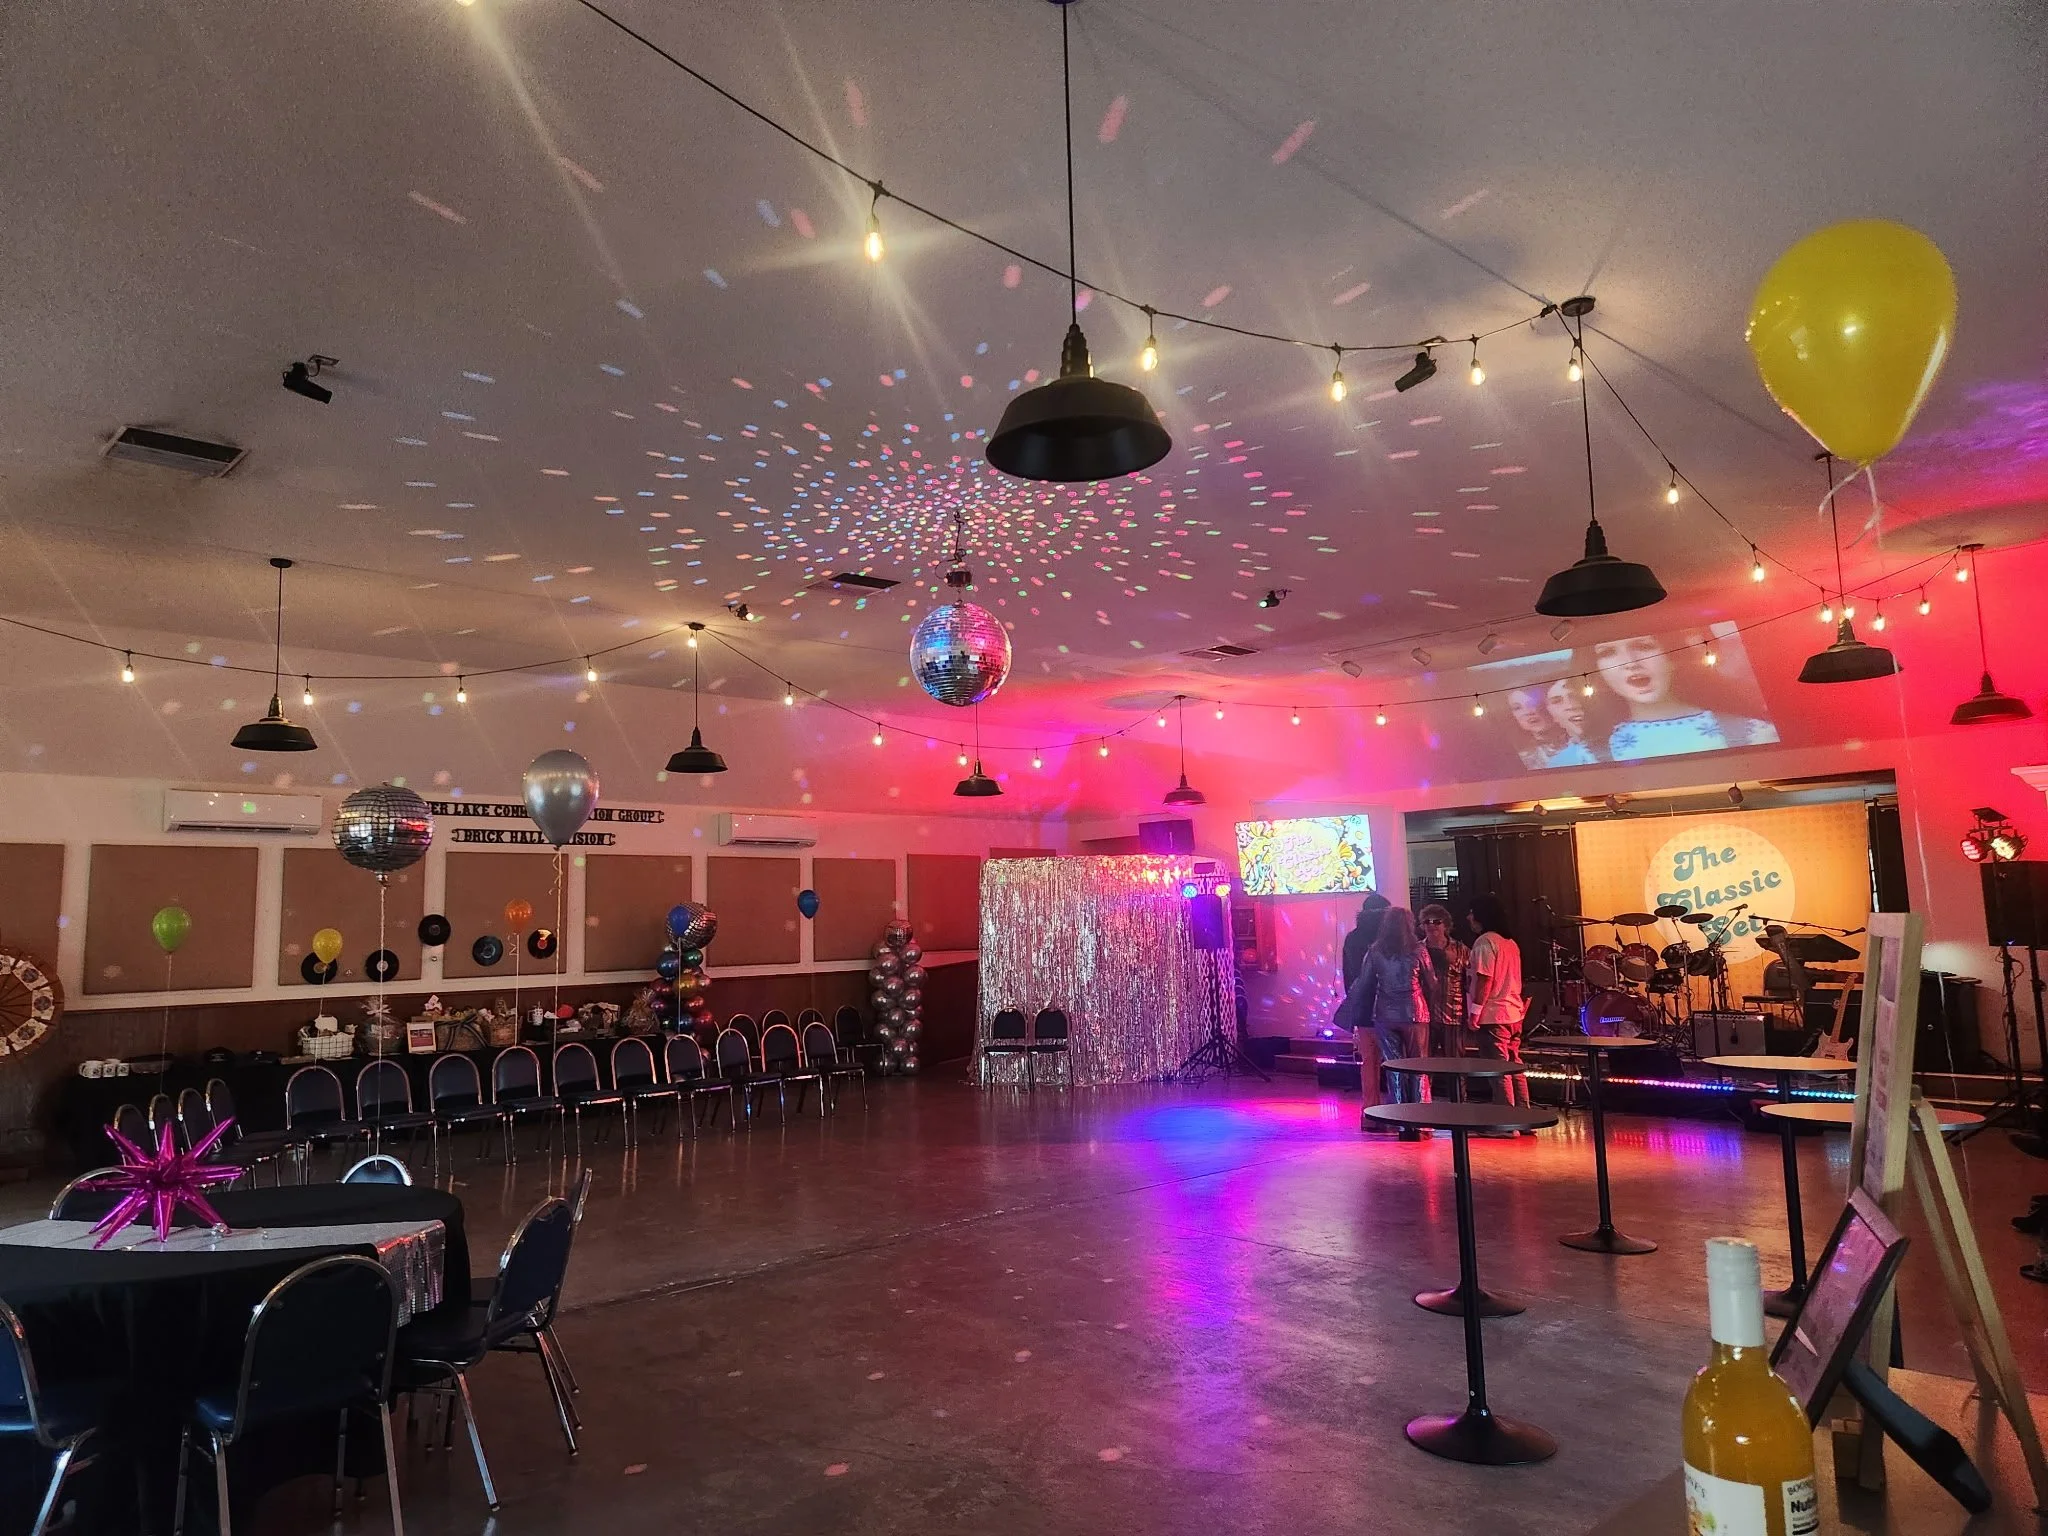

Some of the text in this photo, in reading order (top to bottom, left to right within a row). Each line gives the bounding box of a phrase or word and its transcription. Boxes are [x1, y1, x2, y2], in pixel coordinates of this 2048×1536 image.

[431, 802, 448, 815] ER
[454, 803, 490, 816] LAKE
[494, 804, 528, 818] COMM
[618, 809, 656, 822] GROUP
[464, 829, 604, 845] BRICK HALL ISION
[1673, 846, 1737, 881] The
[1656, 869, 1782, 914] Classic
